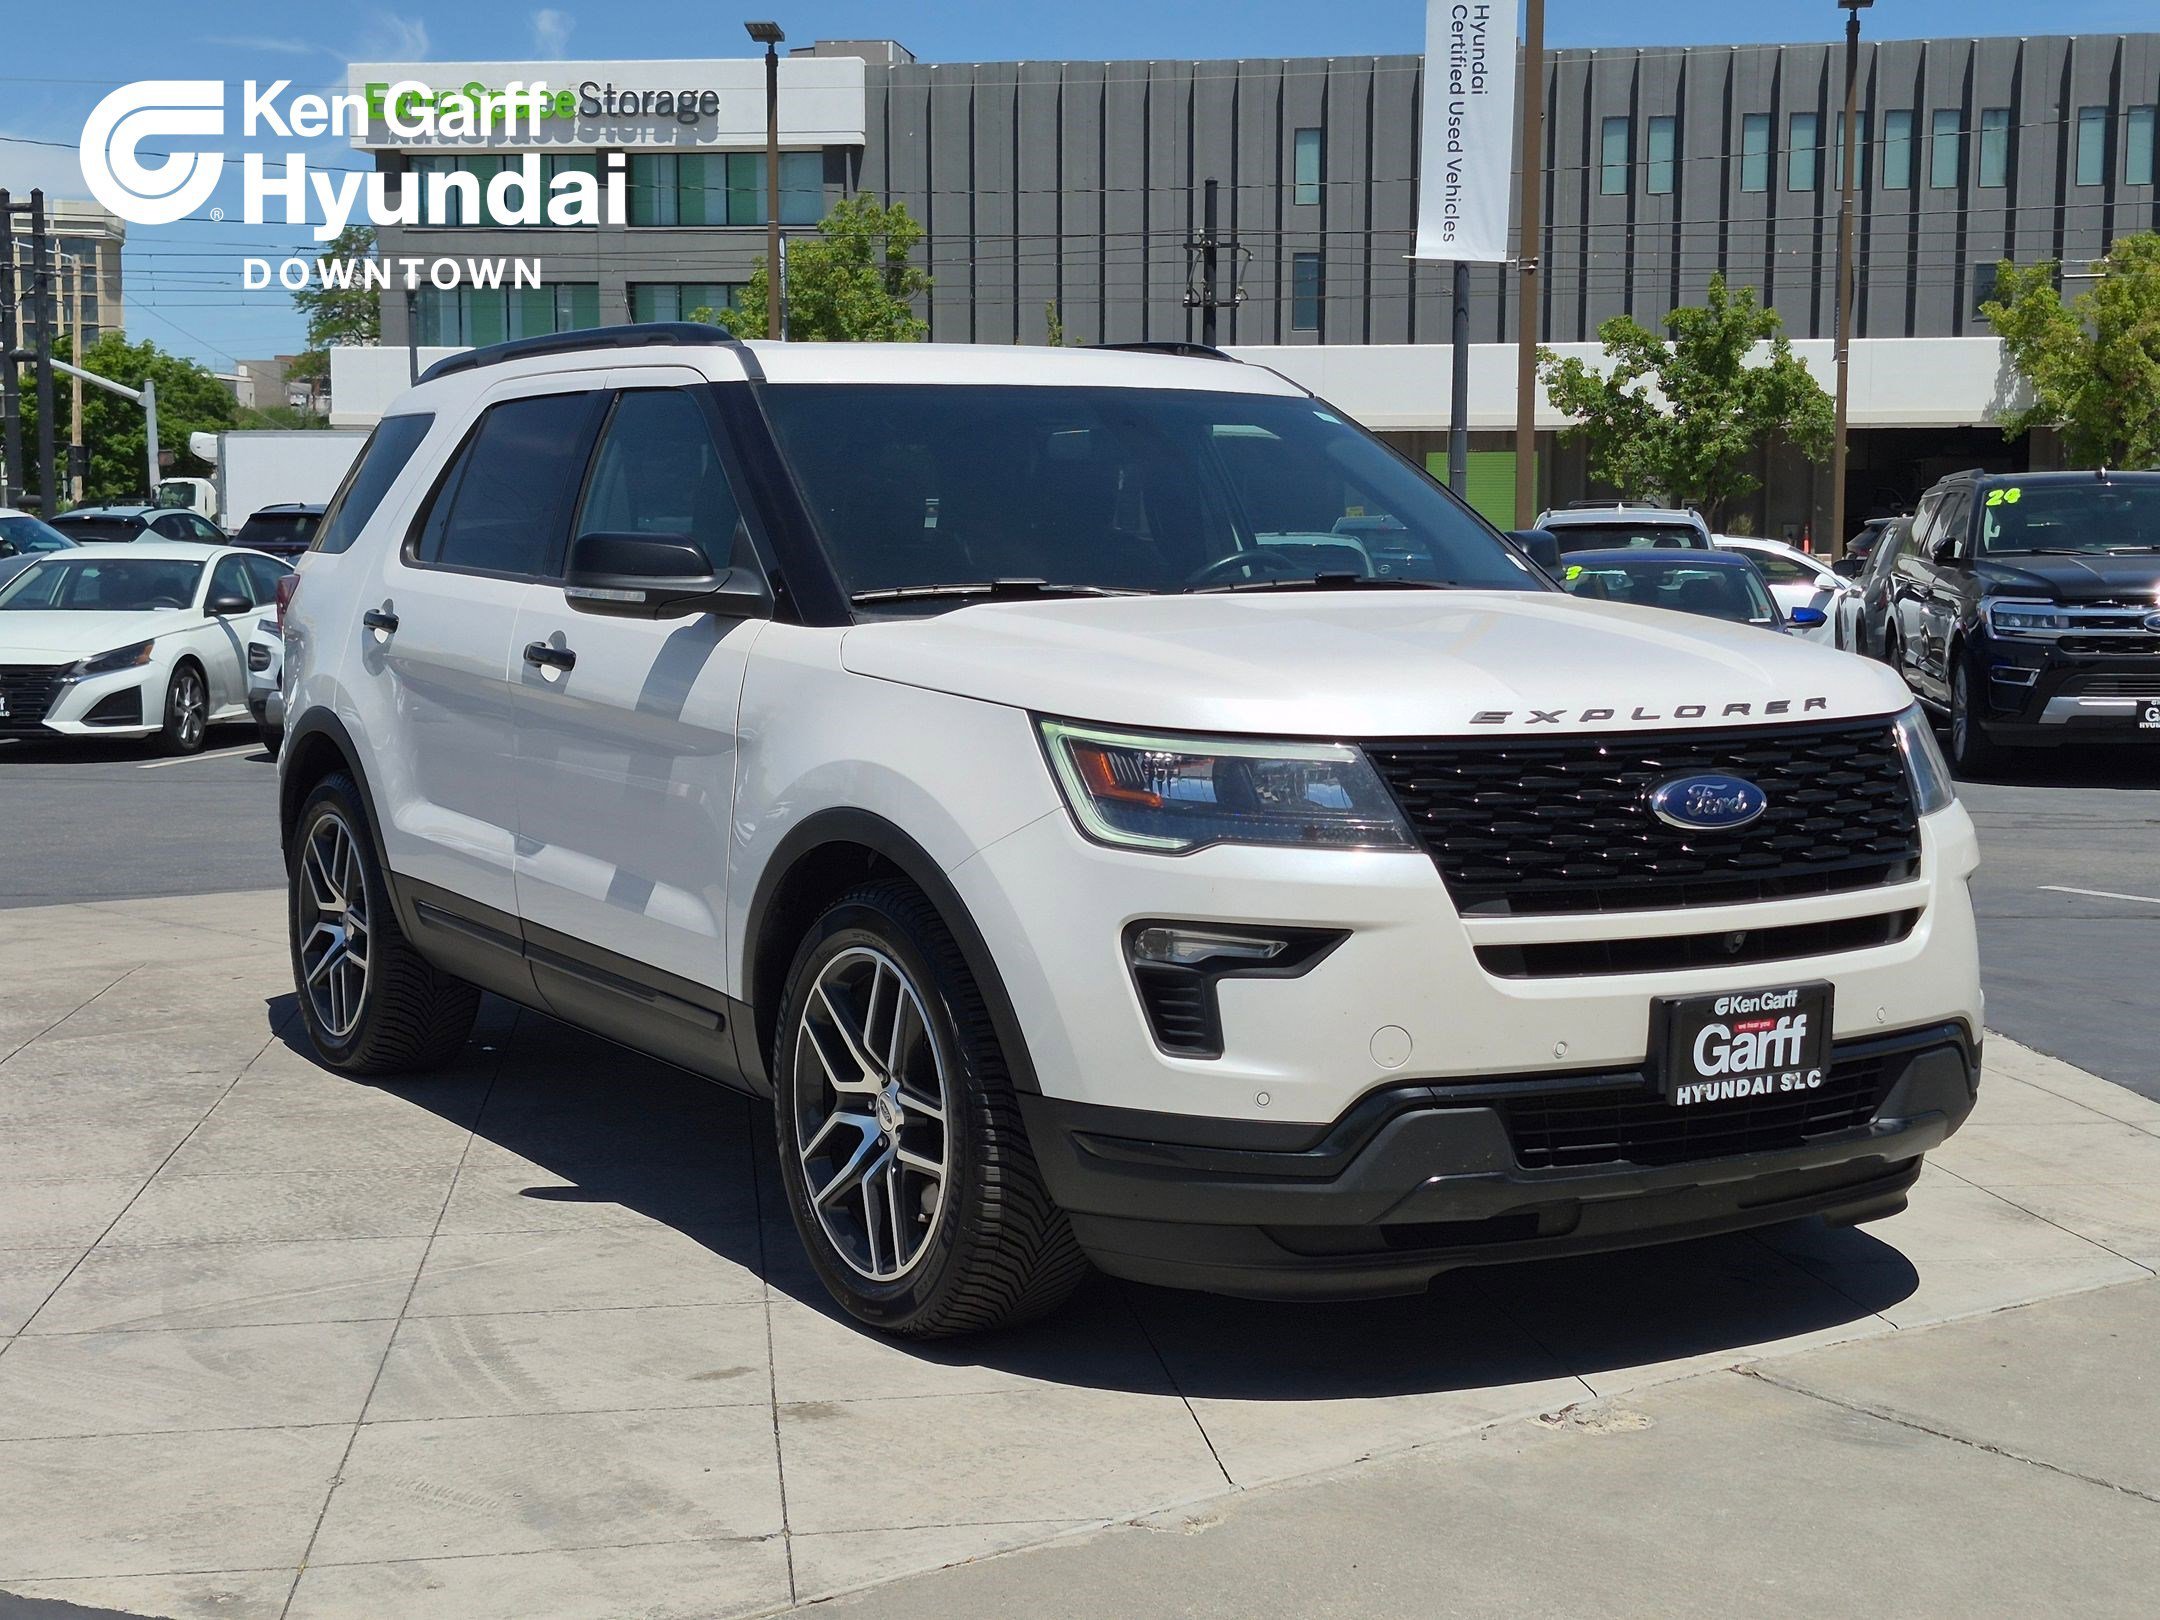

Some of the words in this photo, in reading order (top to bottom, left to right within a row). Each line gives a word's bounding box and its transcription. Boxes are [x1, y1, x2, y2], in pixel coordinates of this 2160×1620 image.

[1450, 4, 1468, 95] Certified
[1470, 4, 1490, 95] Hyundai
[1447, 101, 1465, 153] Used
[1443, 157, 1462, 243] Vehicles
[1468, 696, 1828, 725] EXPLORER
[1685, 783, 1748, 817] Ford
[1729, 995, 1760, 1015] Ken
[1760, 989, 1798, 1010] Garff
[1693, 1013, 1808, 1077] Garff
[1676, 1075, 1774, 1106] HYUNDAI
[1780, 1069, 1821, 1092] SLC
